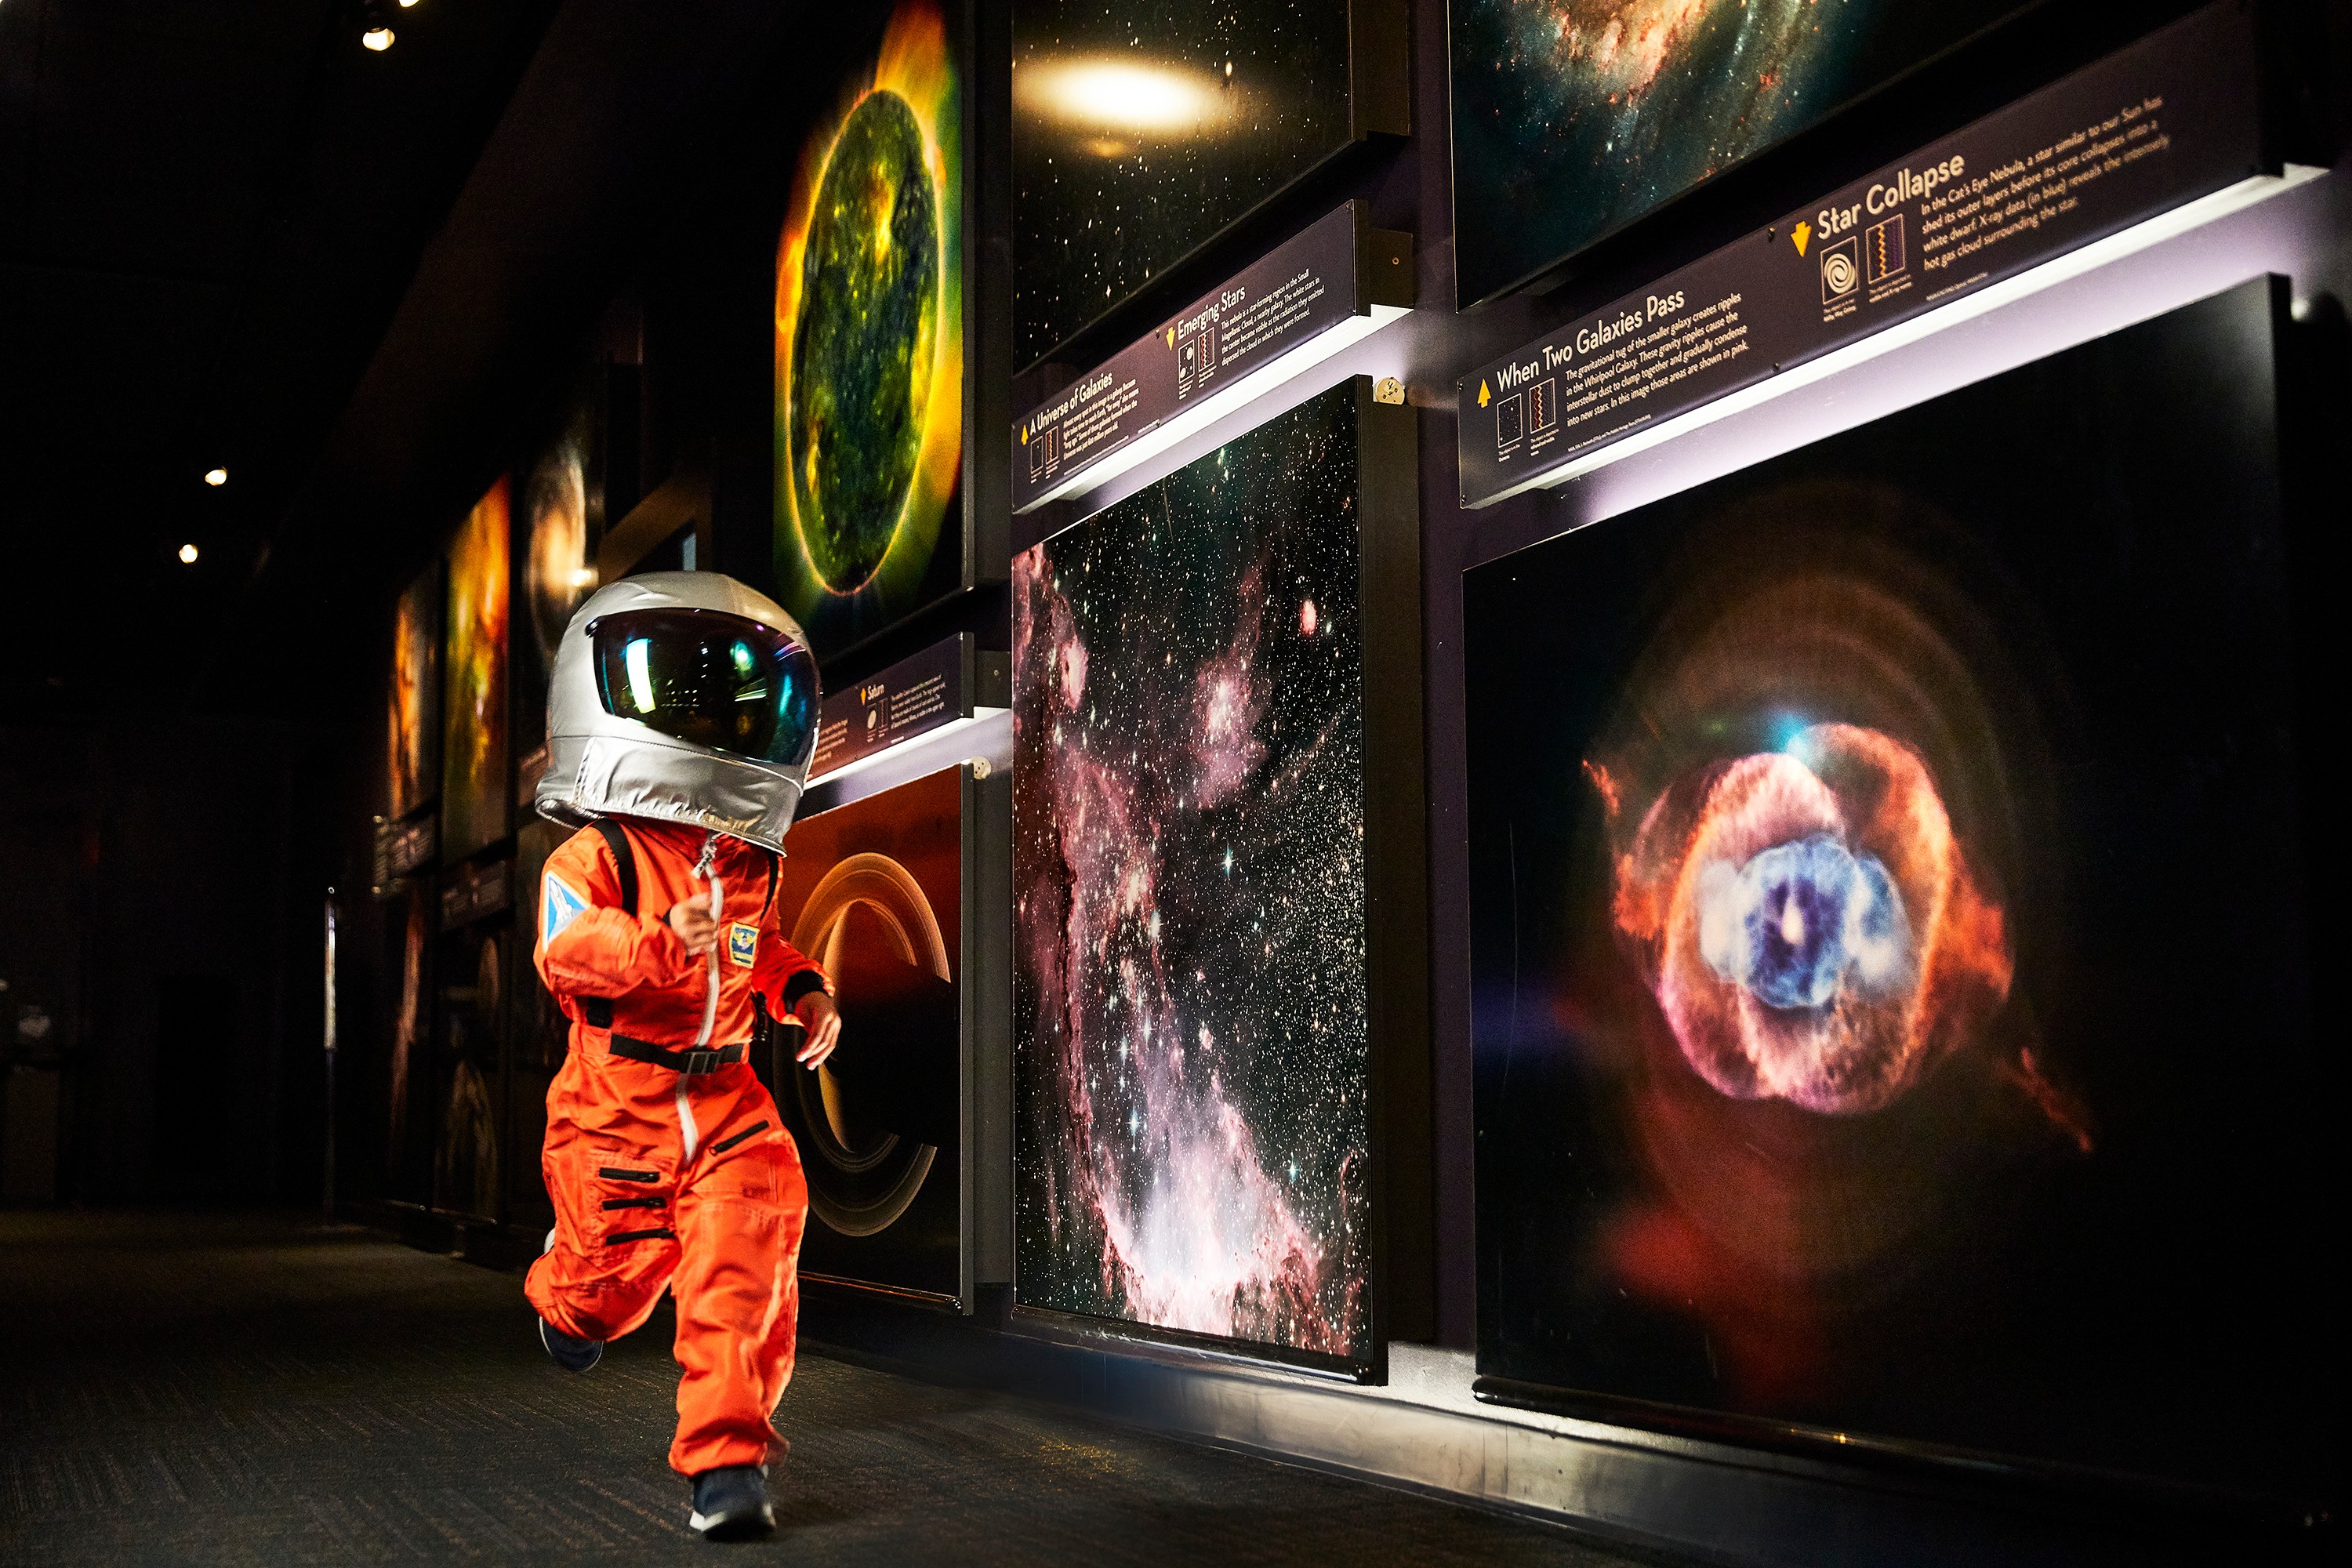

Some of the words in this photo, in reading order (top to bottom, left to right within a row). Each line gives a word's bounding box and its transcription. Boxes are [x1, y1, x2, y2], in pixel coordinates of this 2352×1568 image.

[1817, 203, 1861, 239] Star
[1866, 155, 1964, 214] Collapse
[1178, 303, 1219, 340] Emerging
[1221, 286, 1245, 311] Stars
[1497, 361, 1539, 392] When
[1541, 345, 1572, 370] Two
[1576, 310, 1642, 354] Galaxies
[1646, 290, 1684, 321] Pass
[1565, 368, 1577, 380] The
[1577, 349, 1614, 378] gravitational
[1615, 347, 1626, 358] tug
[1627, 339, 1634, 352] of
[1635, 336, 1646, 348] the
[1646, 325, 1669, 343] smaller
[1670, 316, 1691, 336] galaxy
[1692, 304, 1716, 321] creates
[1717, 292, 1741, 311] ripples
[1566, 387, 1572, 396] in
[1573, 382, 1583, 393] the
[1584, 365, 1614, 387] Whirlpool
[1615, 358, 1638, 373] Galaxy.
[1638, 348, 1657, 362] These
[1658, 337, 1681, 358] gravity
[1682, 326, 1704, 344] ripples
[1705, 318, 1724, 332] cause
[1725, 311, 1738, 323] the
[1029, 418, 1036, 435] A
[1036, 401, 1069, 430] Universe
[1069, 387, 1078, 409] of
[1079, 372, 1112, 402] Galaxies
[1566, 390, 1597, 412] interstellar
[1598, 384, 1612, 397] dust
[1613, 382, 1620, 390] to
[1621, 372, 1640, 387] clump
[1641, 359, 1668, 379] together
[1669, 350, 1682, 365] and
[1682, 338, 1712, 363] gradually
[1714, 325, 1747, 345] condense
[1566, 416, 1579, 426] into
[1580, 409, 1593, 421] new
[1594, 402, 1610, 415] stars.
[1610, 397, 1617, 407] In
[1617, 392, 1630, 404] this
[1630, 385, 1649, 398] image
[1650, 376, 1668, 390] those
[1669, 368, 1686, 382] areas
[1687, 363, 1697, 374] are
[1699, 353, 1722, 368] shown
[1722, 348, 1730, 358] in
[1731, 339, 1748, 358] pink.
